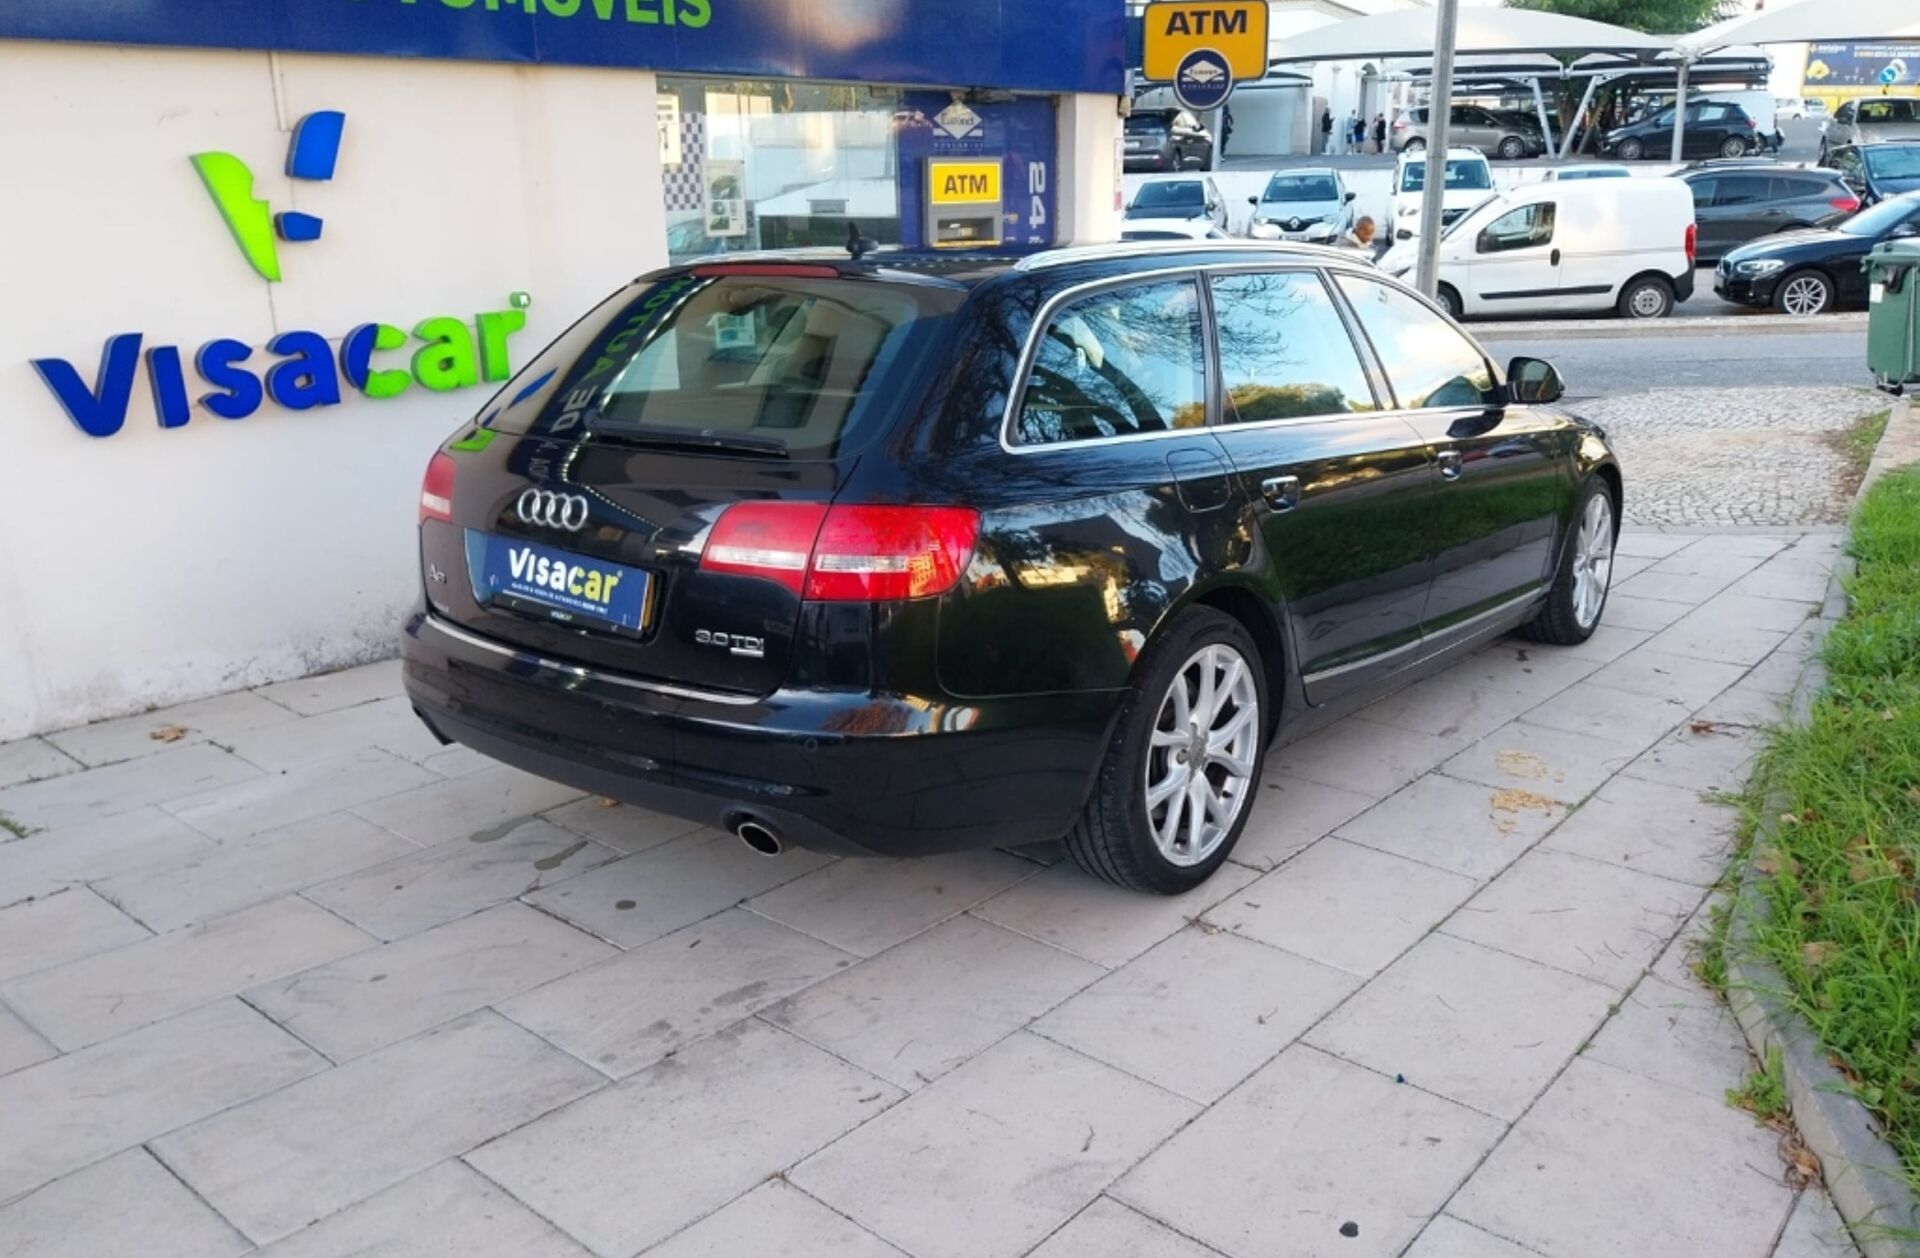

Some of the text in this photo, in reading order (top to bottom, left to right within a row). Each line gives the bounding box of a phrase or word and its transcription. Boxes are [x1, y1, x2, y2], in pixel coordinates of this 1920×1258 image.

[1165, 10, 1247, 35] ATM
[944, 174, 988, 195] ATM
[1029, 161, 1045, 229] 24
